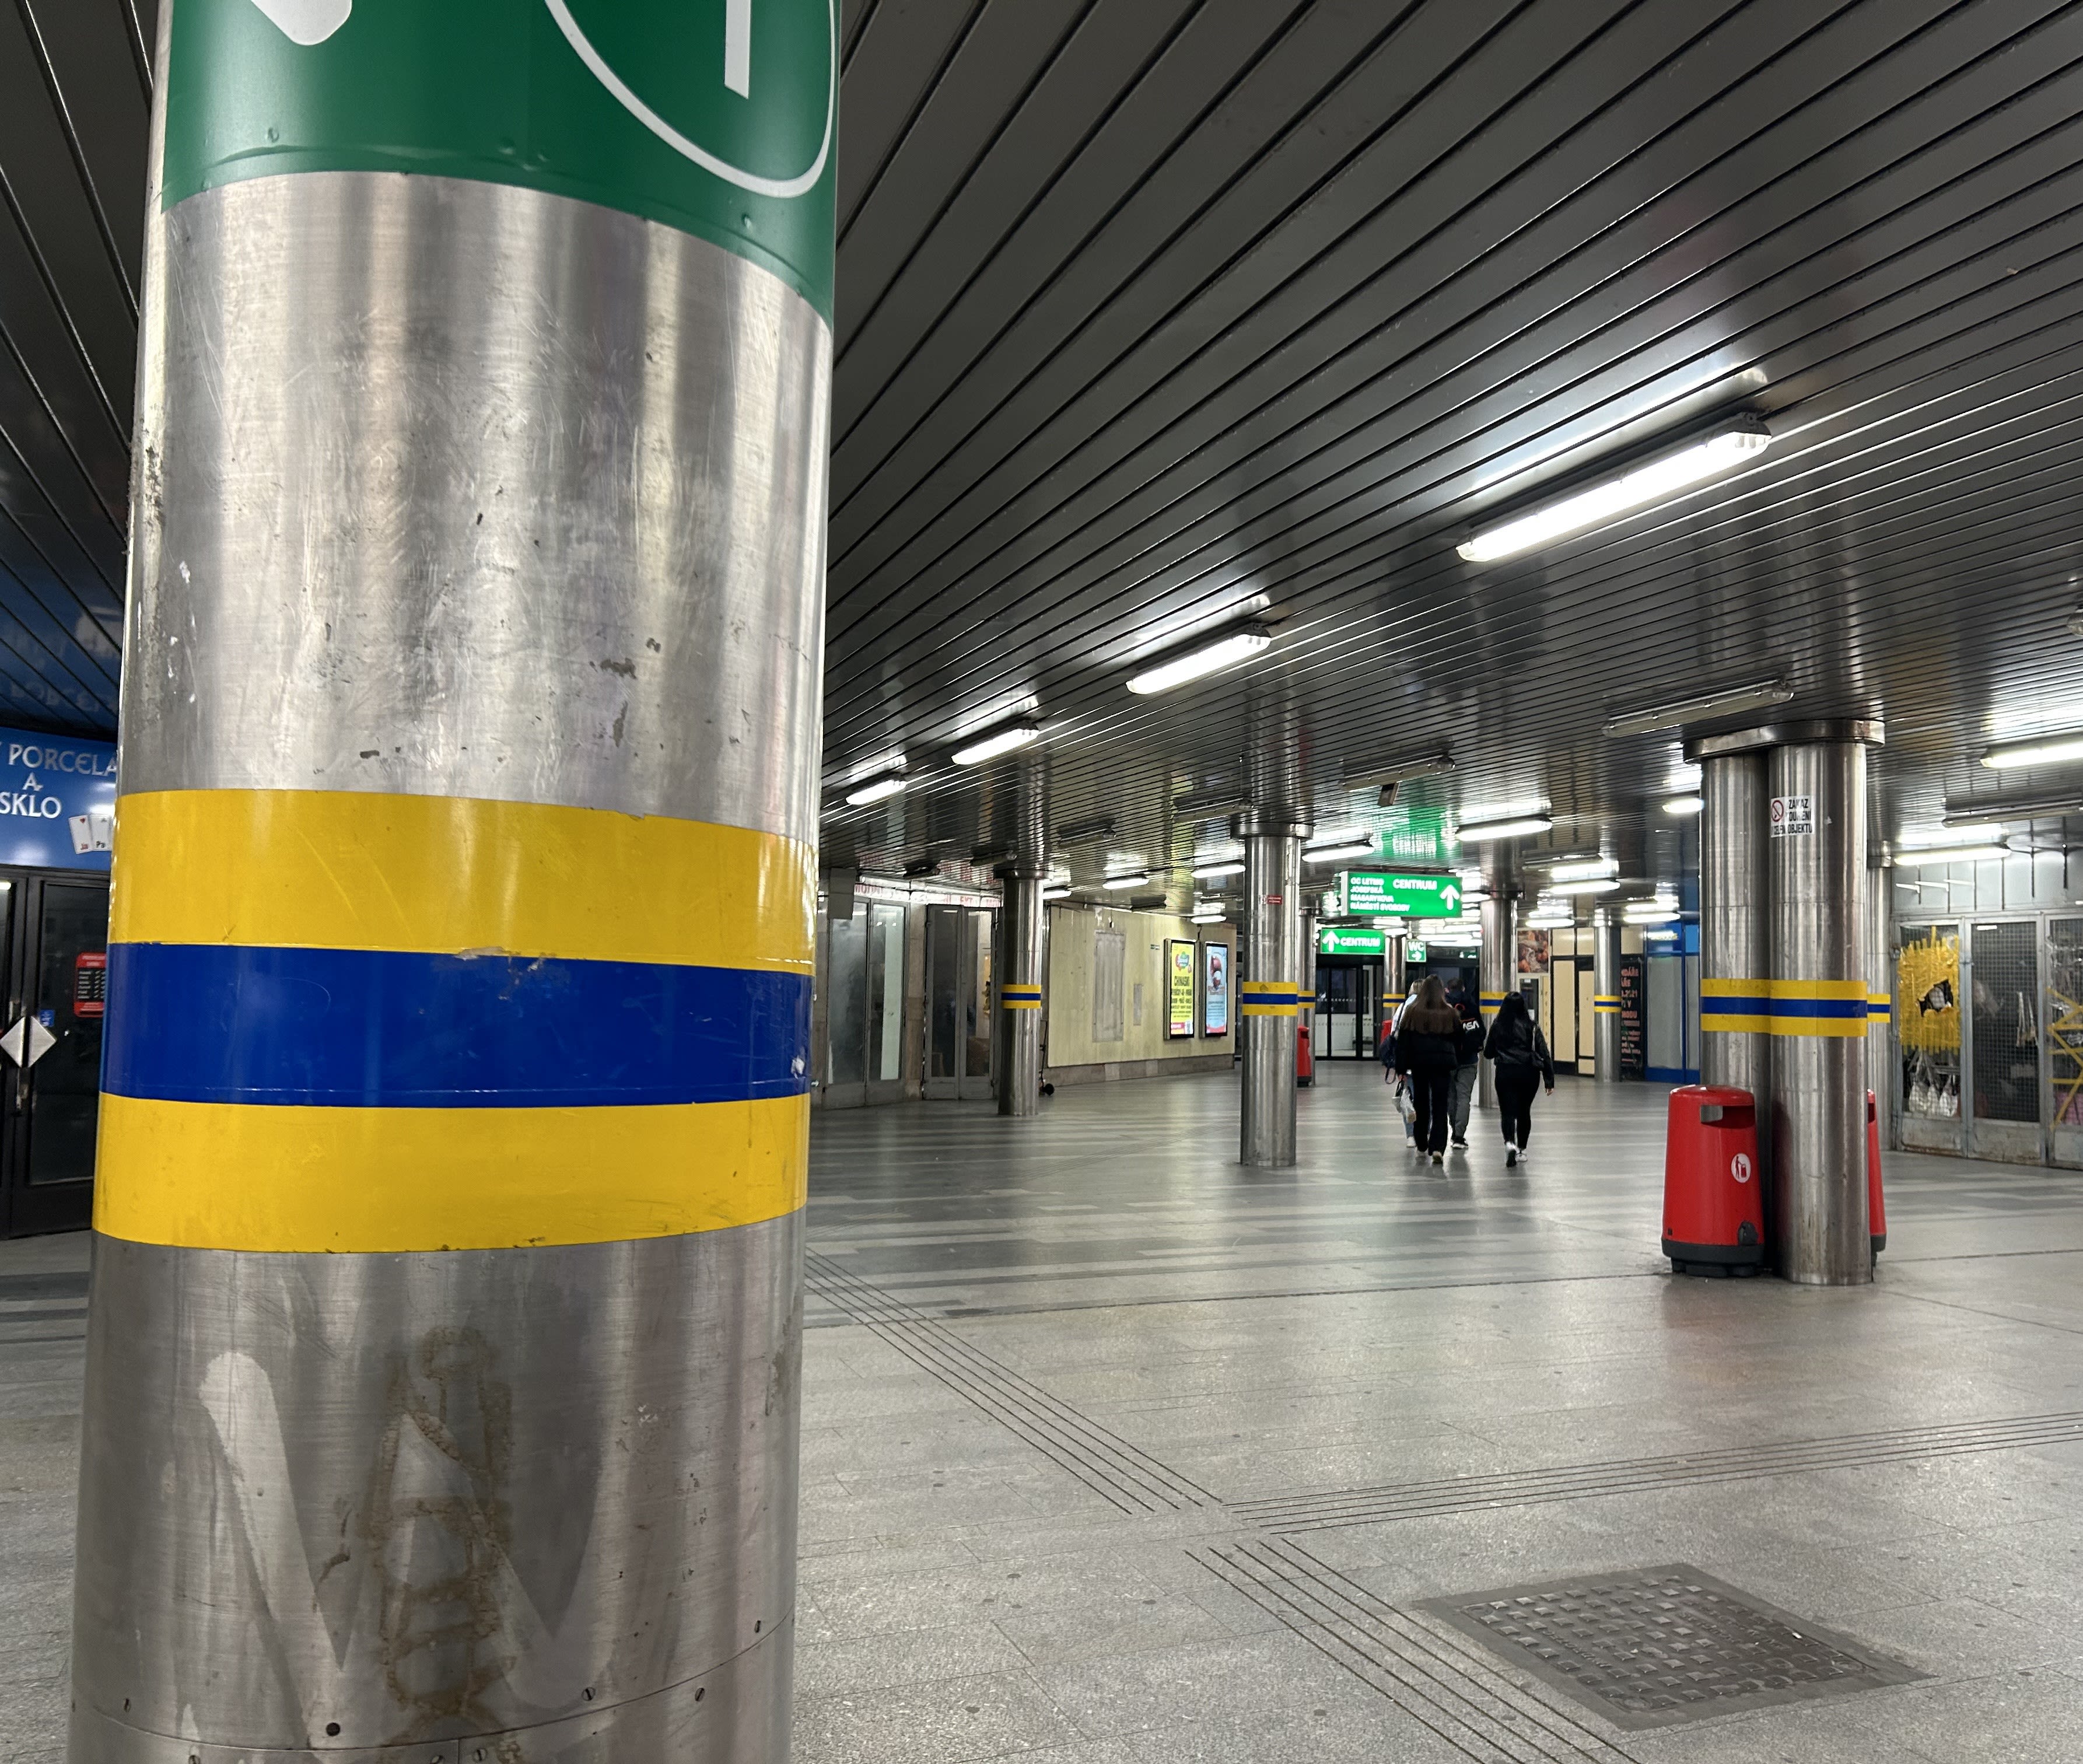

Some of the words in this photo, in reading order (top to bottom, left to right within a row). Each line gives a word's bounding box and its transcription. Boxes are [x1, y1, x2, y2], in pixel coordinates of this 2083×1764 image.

[9, 744, 117, 776] PORCELA
[23, 772, 43, 791] A
[0, 792, 61, 818] SKLO
[1788, 823, 1812, 834] OBJEKTU
[1393, 878, 1437, 890] CENTRUM
[1340, 937, 1381, 947] CENTRUM
[1408, 941, 1424, 951] WC
